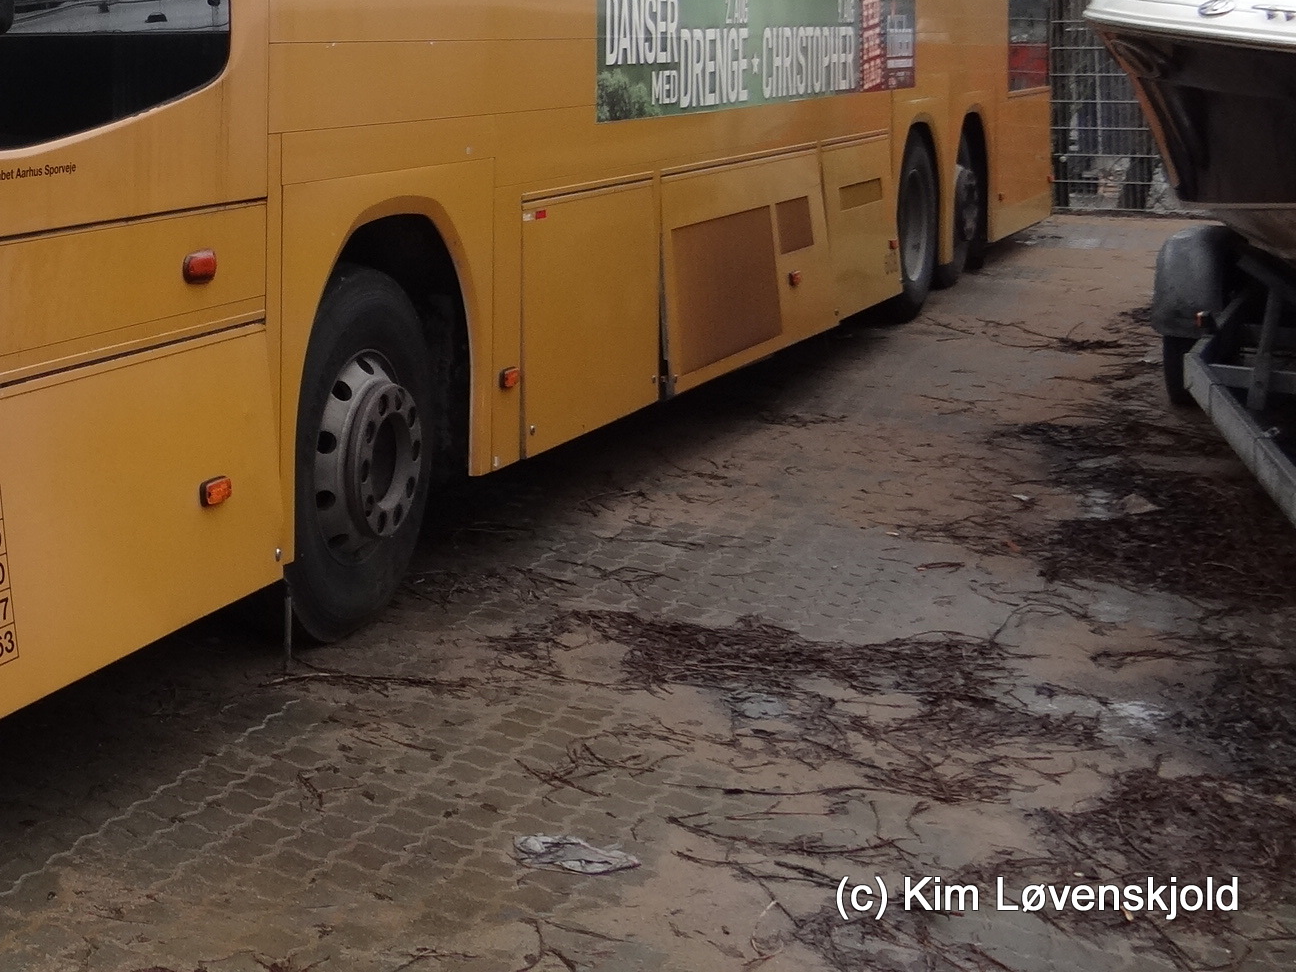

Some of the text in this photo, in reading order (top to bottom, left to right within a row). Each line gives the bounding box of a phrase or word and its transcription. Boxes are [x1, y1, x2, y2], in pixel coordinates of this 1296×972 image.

[651, 70, 678, 106] MED
[679, 28, 749, 109] DRENGE
[762, 26, 855, 99] CHRISTOPHER
[15, 166, 43, 179] Aarhus
[44, 162, 77, 177] Sporveje
